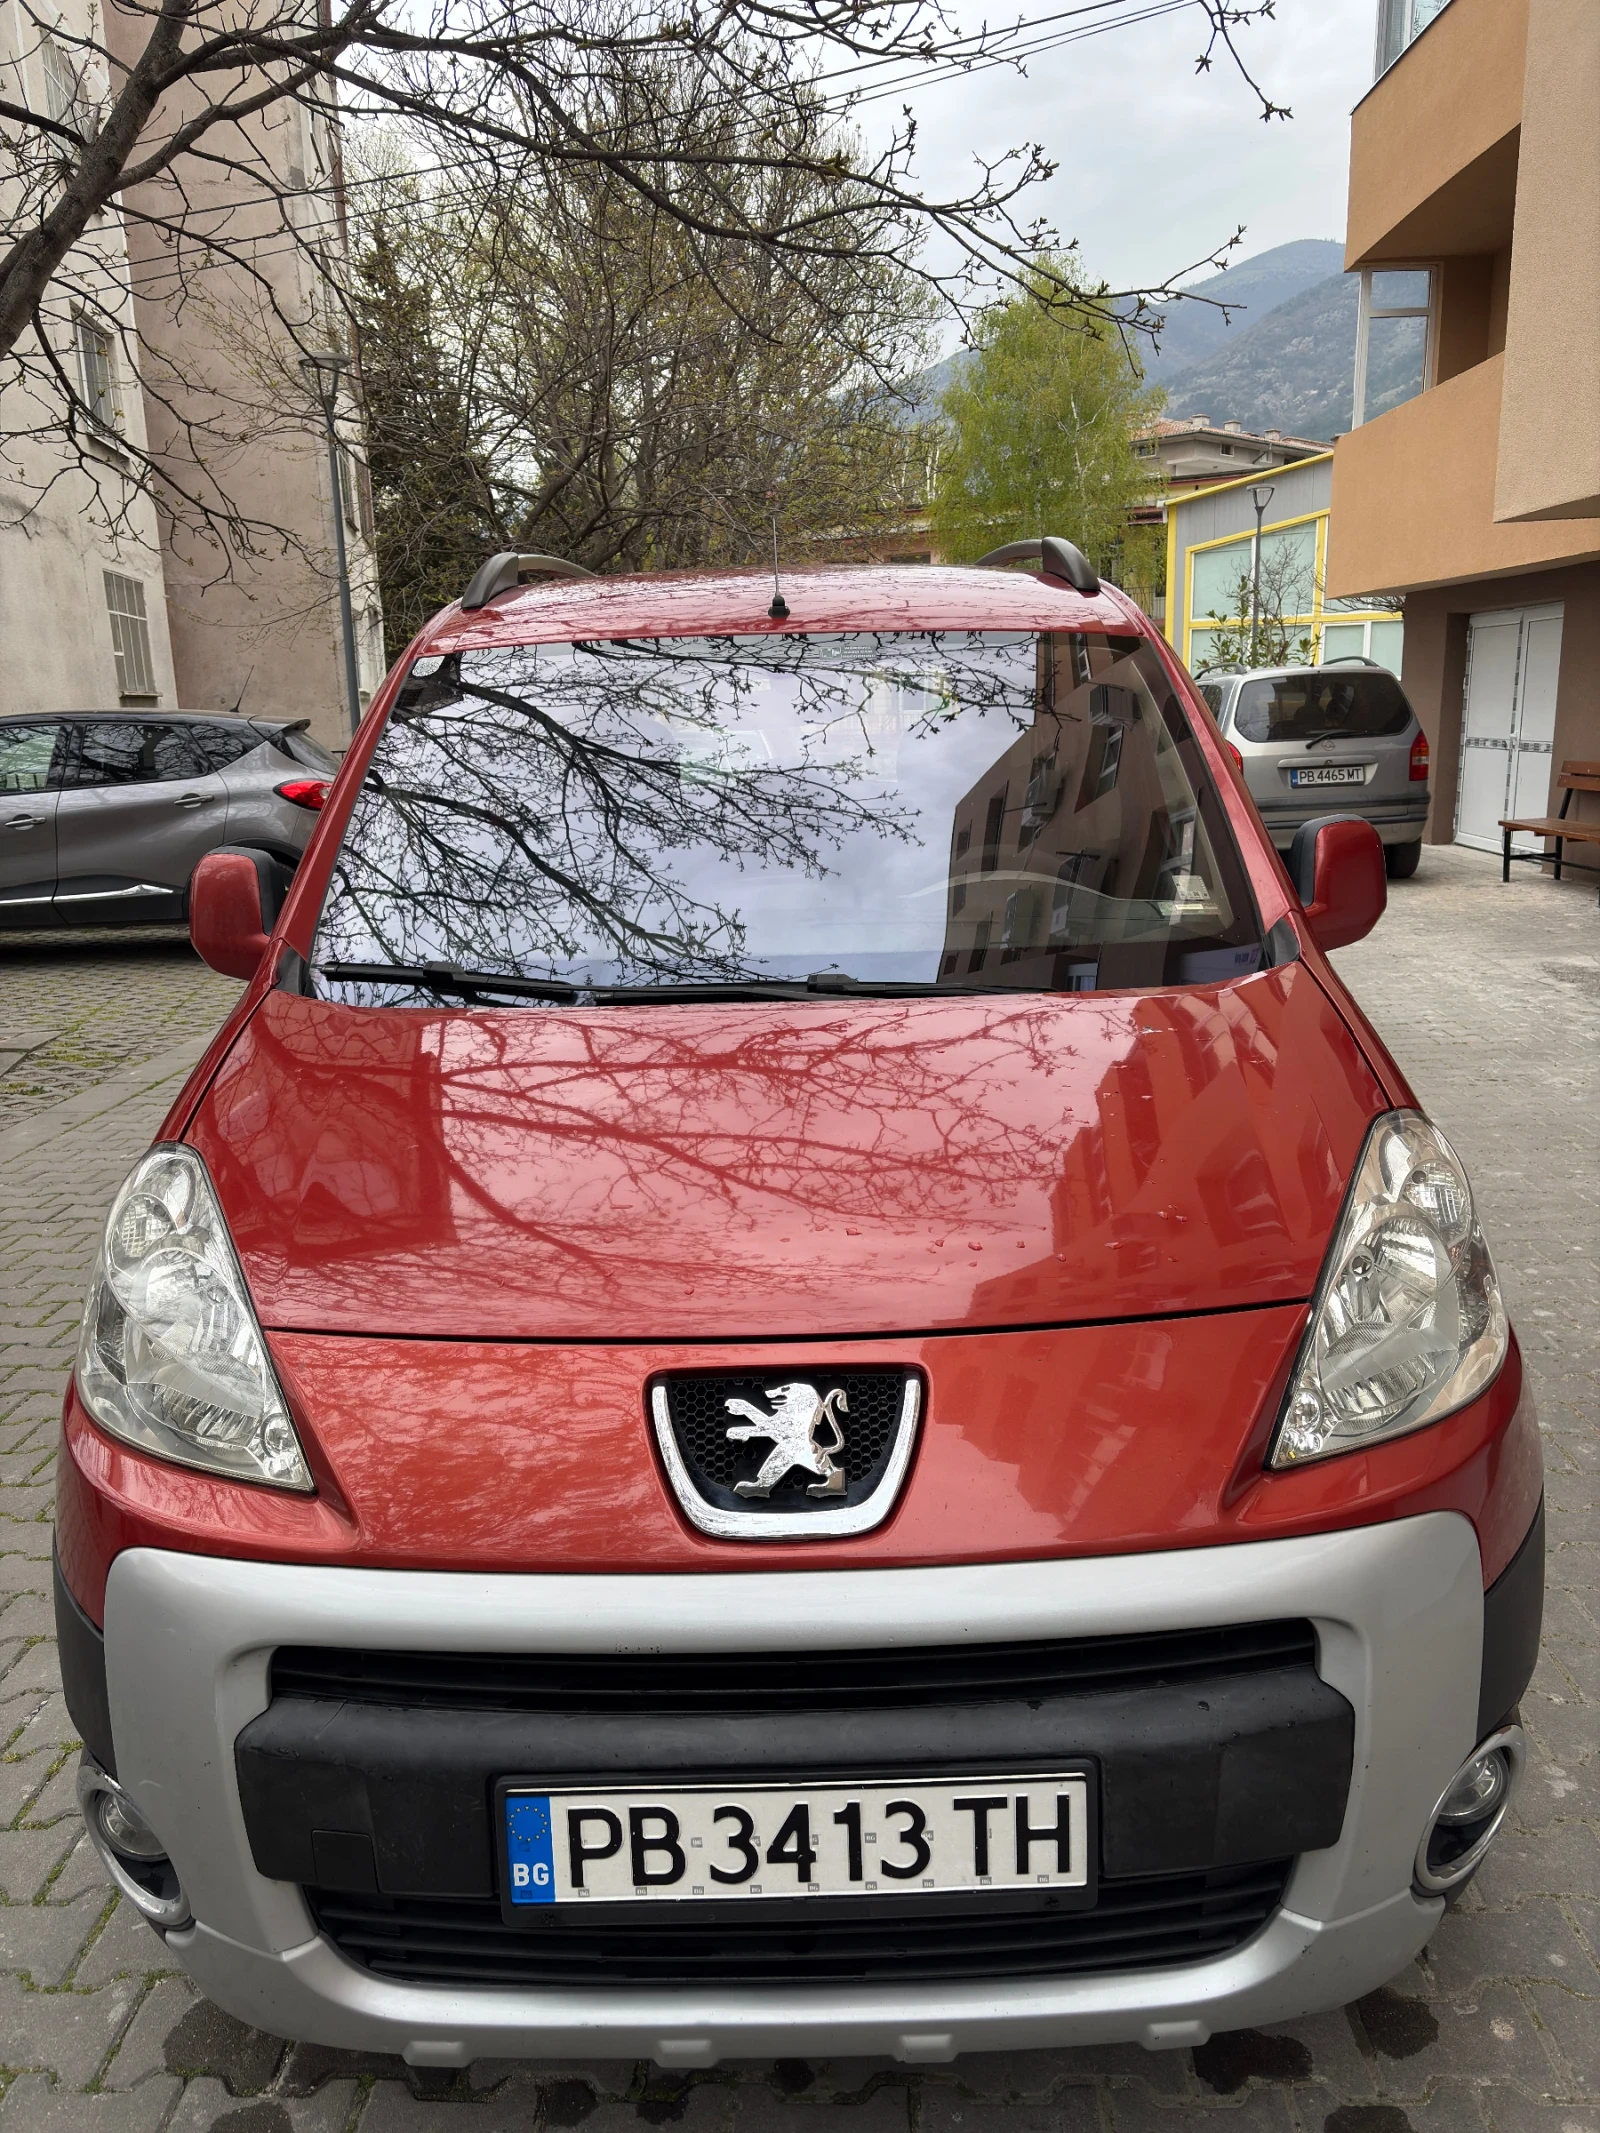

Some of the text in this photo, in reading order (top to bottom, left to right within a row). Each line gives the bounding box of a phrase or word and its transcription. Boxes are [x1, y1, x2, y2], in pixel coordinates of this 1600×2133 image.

[1300, 770, 1315, 783] PB
[1317, 769, 1345, 782] 4465
[1348, 768, 1361, 780] MT
[567, 1793, 1070, 1888] PB 3413 TH
[513, 1862, 549, 1886] BG
